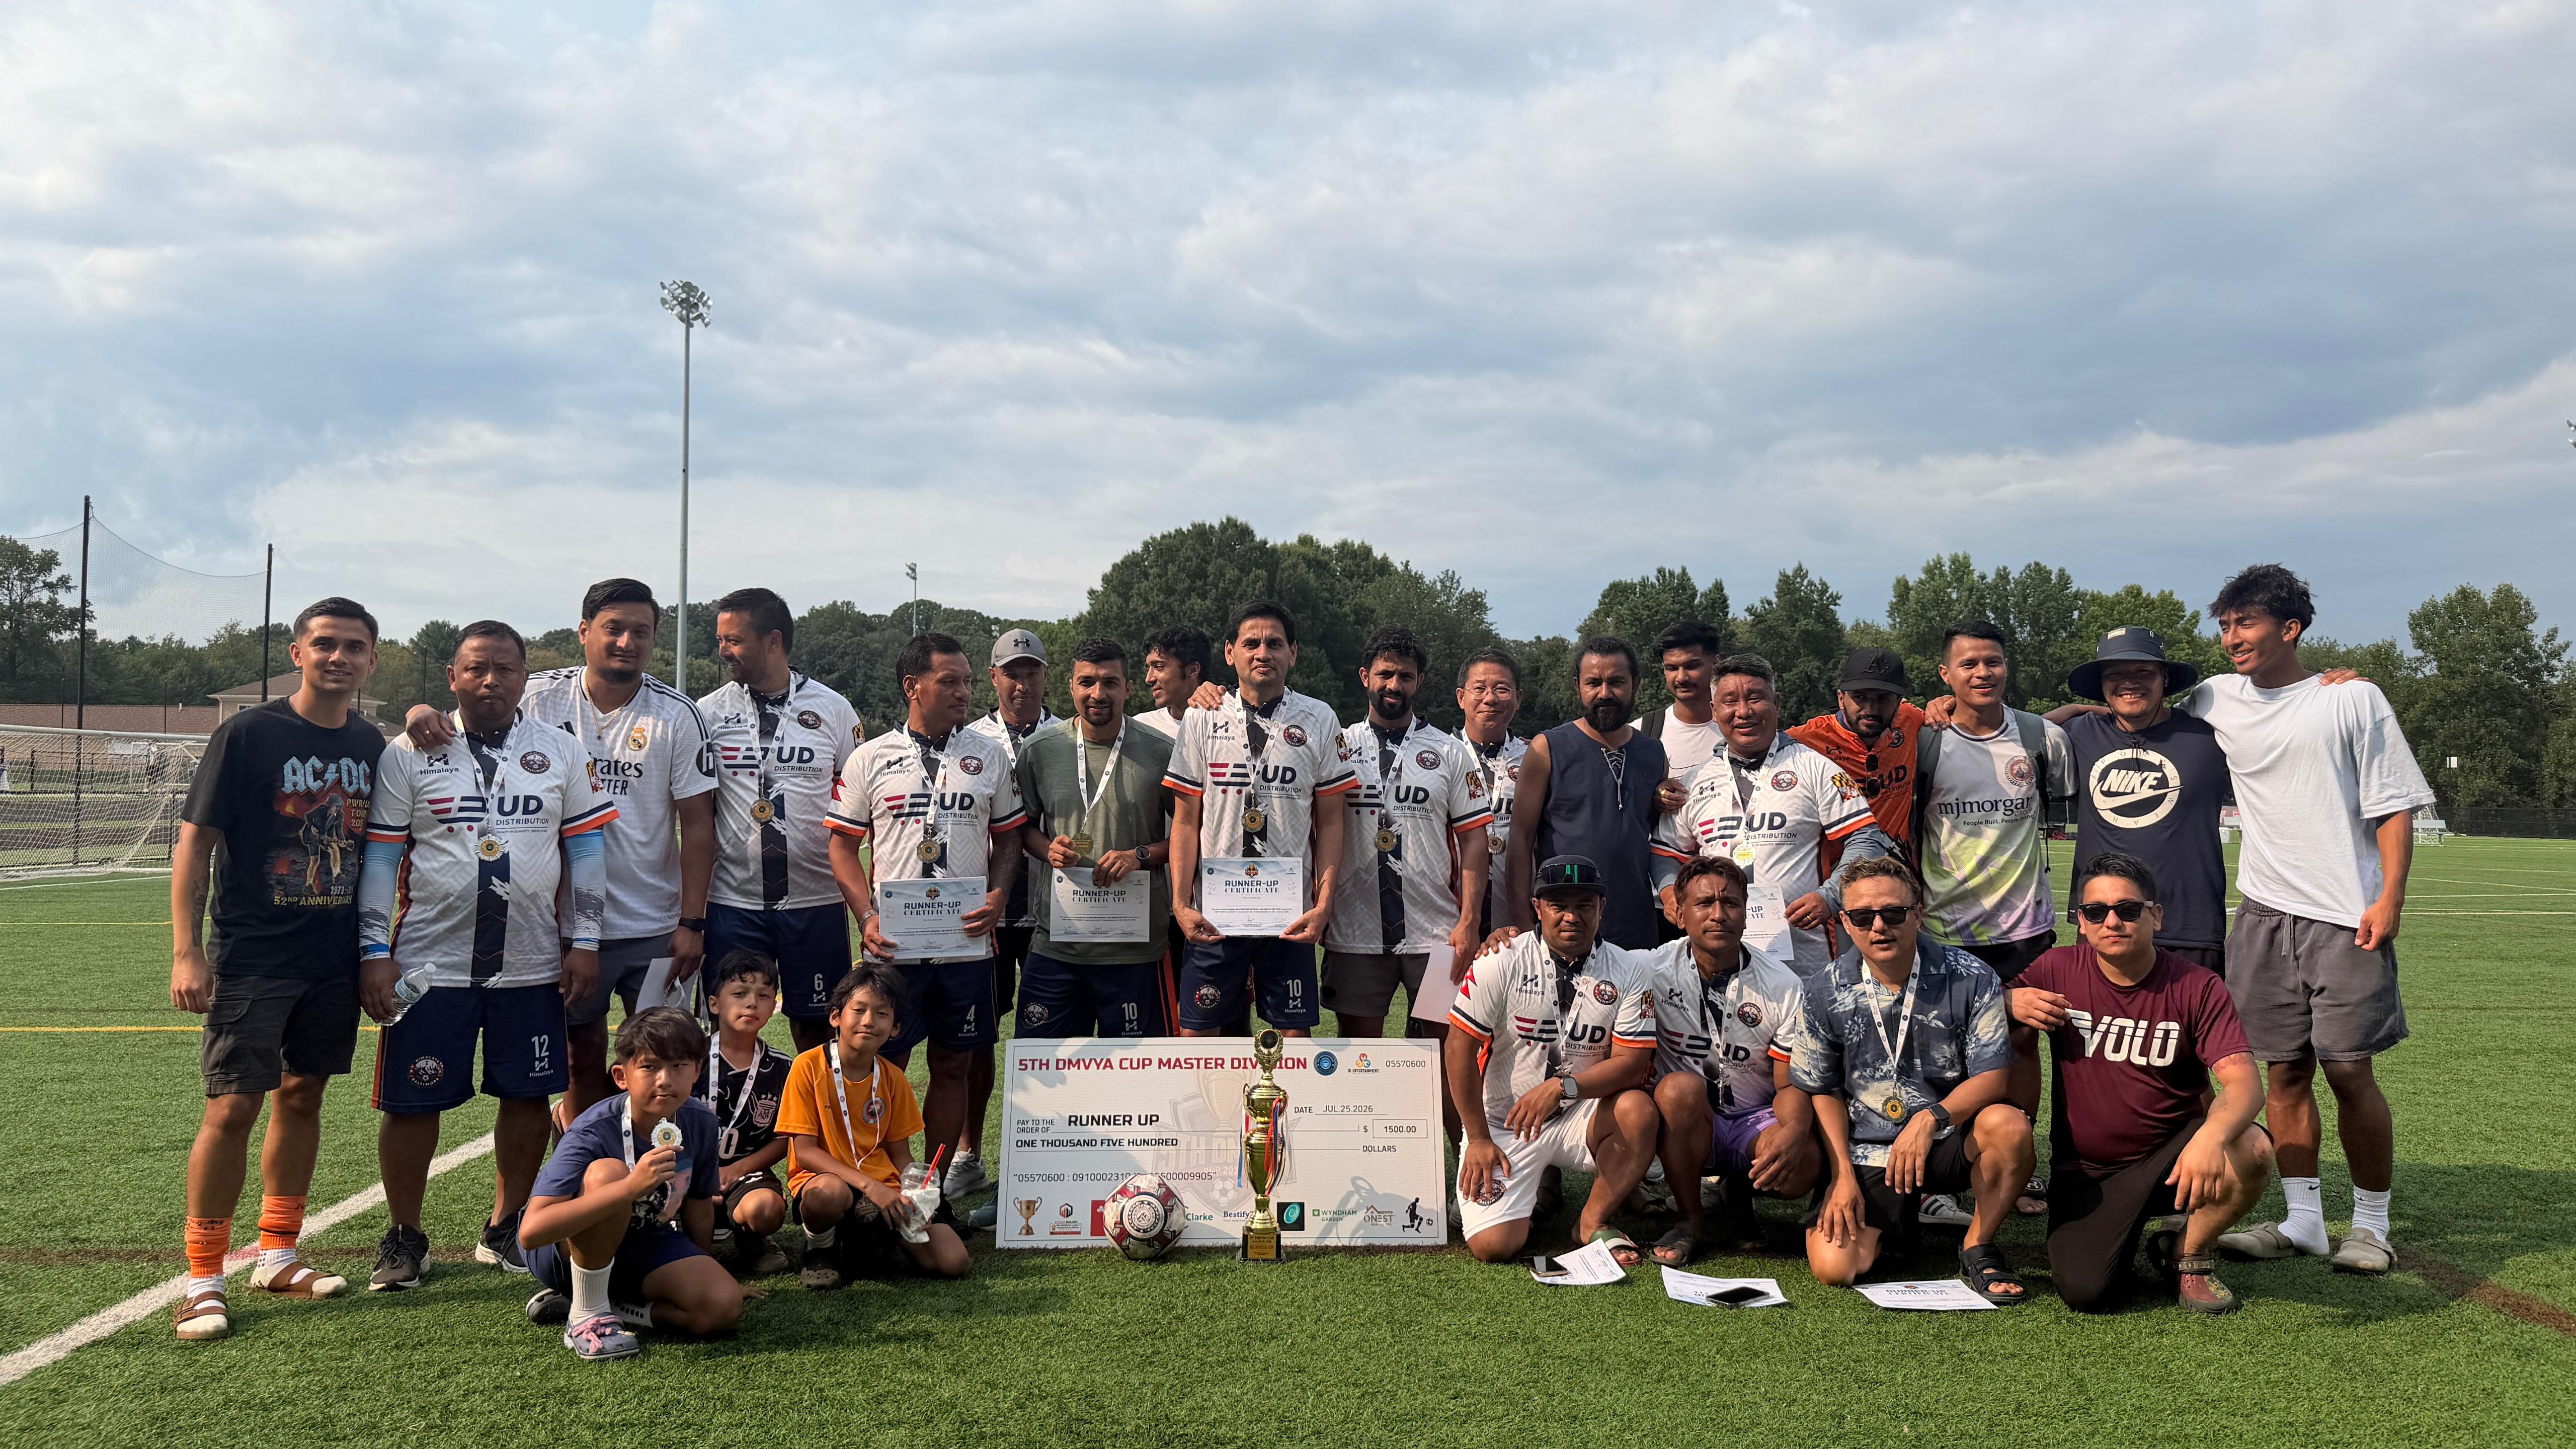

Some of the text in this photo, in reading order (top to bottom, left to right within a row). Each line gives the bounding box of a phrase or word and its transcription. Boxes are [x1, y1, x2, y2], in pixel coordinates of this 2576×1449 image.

[776, 747, 815, 764] UD
[420, 767, 459, 775] Himalaya
[593, 757, 643, 778] rates
[880, 769, 910, 777] Himalaya
[1262, 764, 1297, 784] UD
[1879, 765, 1907, 789] UD
[2101, 769, 2162, 793] NIKE
[601, 778, 628, 795] TTER
[1395, 785, 1429, 804] UD
[497, 795, 543, 817] UD
[940, 792, 975, 811] UD
[1748, 812, 1787, 832] UD
[274, 896, 298, 906] 52ND
[904, 901, 961, 910] RUNNER-UP
[815, 974, 823, 991] 6
[1286, 979, 1302, 997] 10
[1516, 987, 1545, 996] Himalaya
[967, 1005, 975, 1022] 4
[1122, 1003, 1138, 1020] 10
[1661, 999, 1689, 1012] Himalaya
[1568, 1022, 1606, 1043] UD
[2065, 1008, 2180, 1067] VOLO
[531, 1035, 549, 1058] 12
[1018, 1058, 1050, 1071] 5TH
[1055, 1058, 1114, 1071] DMVYA
[1119, 1058, 1152, 1070] CUP
[1158, 1057, 1225, 1070] MASTER
[1231, 1057, 1307, 1070] DIVION
[1322, 1105, 1374, 1113] JUL.25.2026
[1068, 1114, 1160, 1126] RUNNER UP
[1363, 1125, 1369, 1133] $
[1016, 1138, 1178, 1148] ONE THOUSAND FIVE HUNDRED
[1185, 1213, 1214, 1221] Clarke
